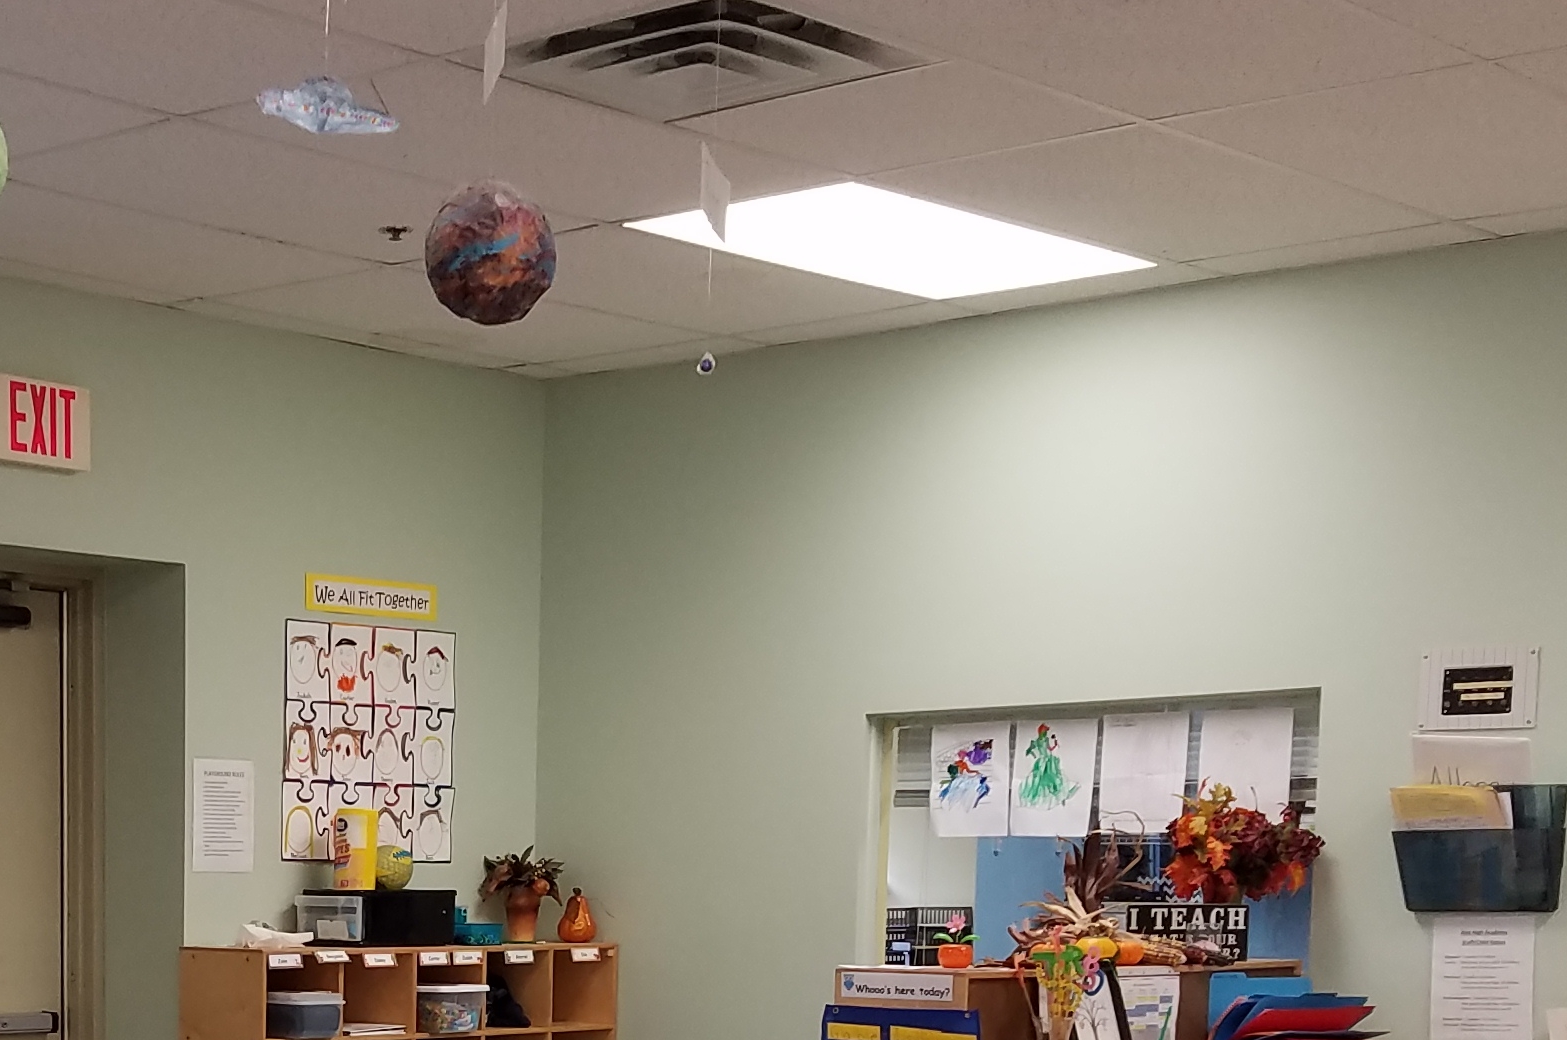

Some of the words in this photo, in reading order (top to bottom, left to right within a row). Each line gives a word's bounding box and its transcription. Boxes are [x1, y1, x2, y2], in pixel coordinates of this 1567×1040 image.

[9, 380, 76, 459] EXIT
[314, 585, 335, 604] We
[338, 588, 357, 606] All
[359, 591, 374, 606] Fit
[376, 592, 429, 611] Together
[1129, 908, 1139, 930] I
[1151, 907, 1247, 930] TEACH
[894, 986, 915, 995] here
[919, 987, 951, 999] today?
